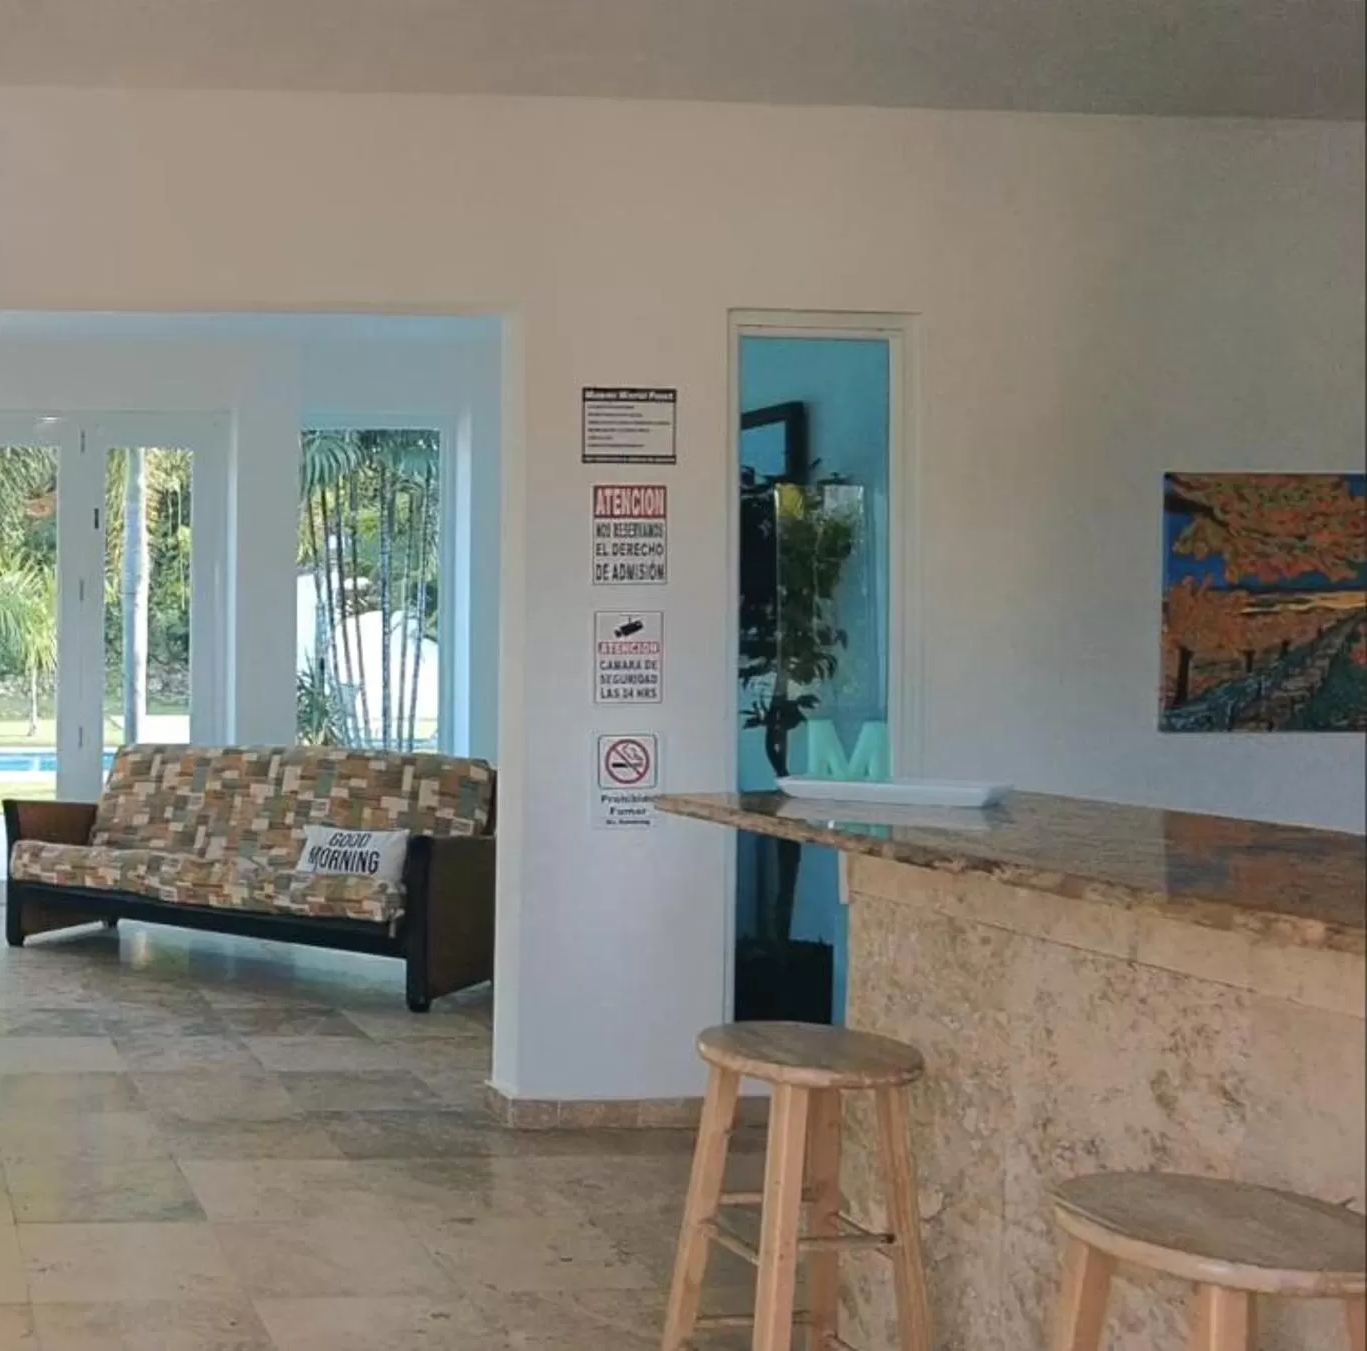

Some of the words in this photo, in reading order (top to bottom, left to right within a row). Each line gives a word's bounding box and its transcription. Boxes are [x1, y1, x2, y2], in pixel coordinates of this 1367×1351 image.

[596, 487, 665, 516] ATENCION
[596, 542, 608, 556] EL
[612, 542, 664, 556] DERECHO
[596, 563, 609, 580] DE
[600, 687, 620, 699] LAS
[329, 832, 371, 848] GOOD
[308, 846, 381, 874] MORNING
